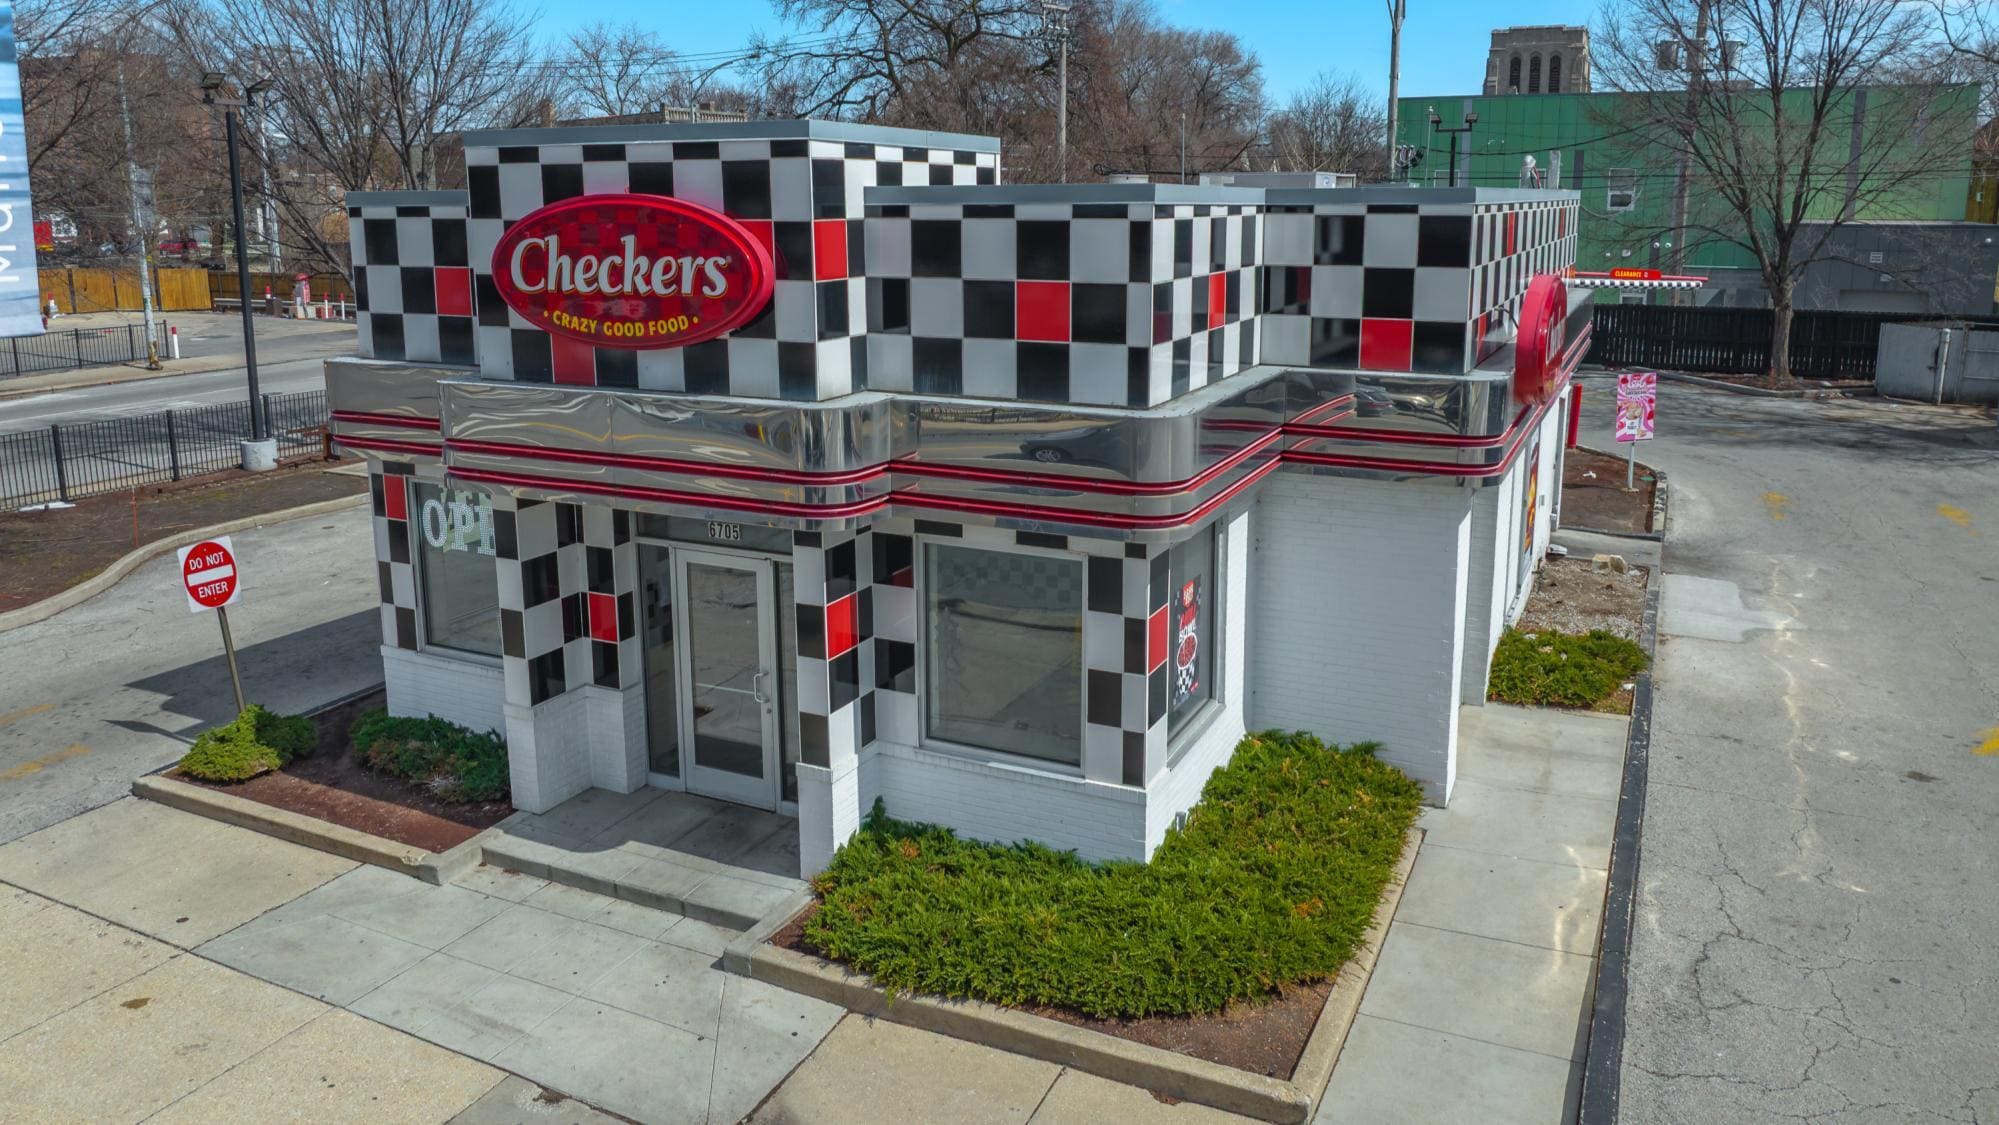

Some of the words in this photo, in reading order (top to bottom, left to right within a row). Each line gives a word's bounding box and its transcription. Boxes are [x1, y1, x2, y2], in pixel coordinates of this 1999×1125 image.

[510, 234, 728, 298] Checkers
[1614, 270, 1642, 278] CLEARANCE
[552, 310, 598, 334] CRAZY
[603, 321, 645, 337] GOOD
[649, 315, 689, 336] FOOD
[709, 521, 740, 540] 6705
[190, 557, 203, 570] DO
[206, 552, 224, 566] NOT
[199, 581, 229, 598] ENTER
